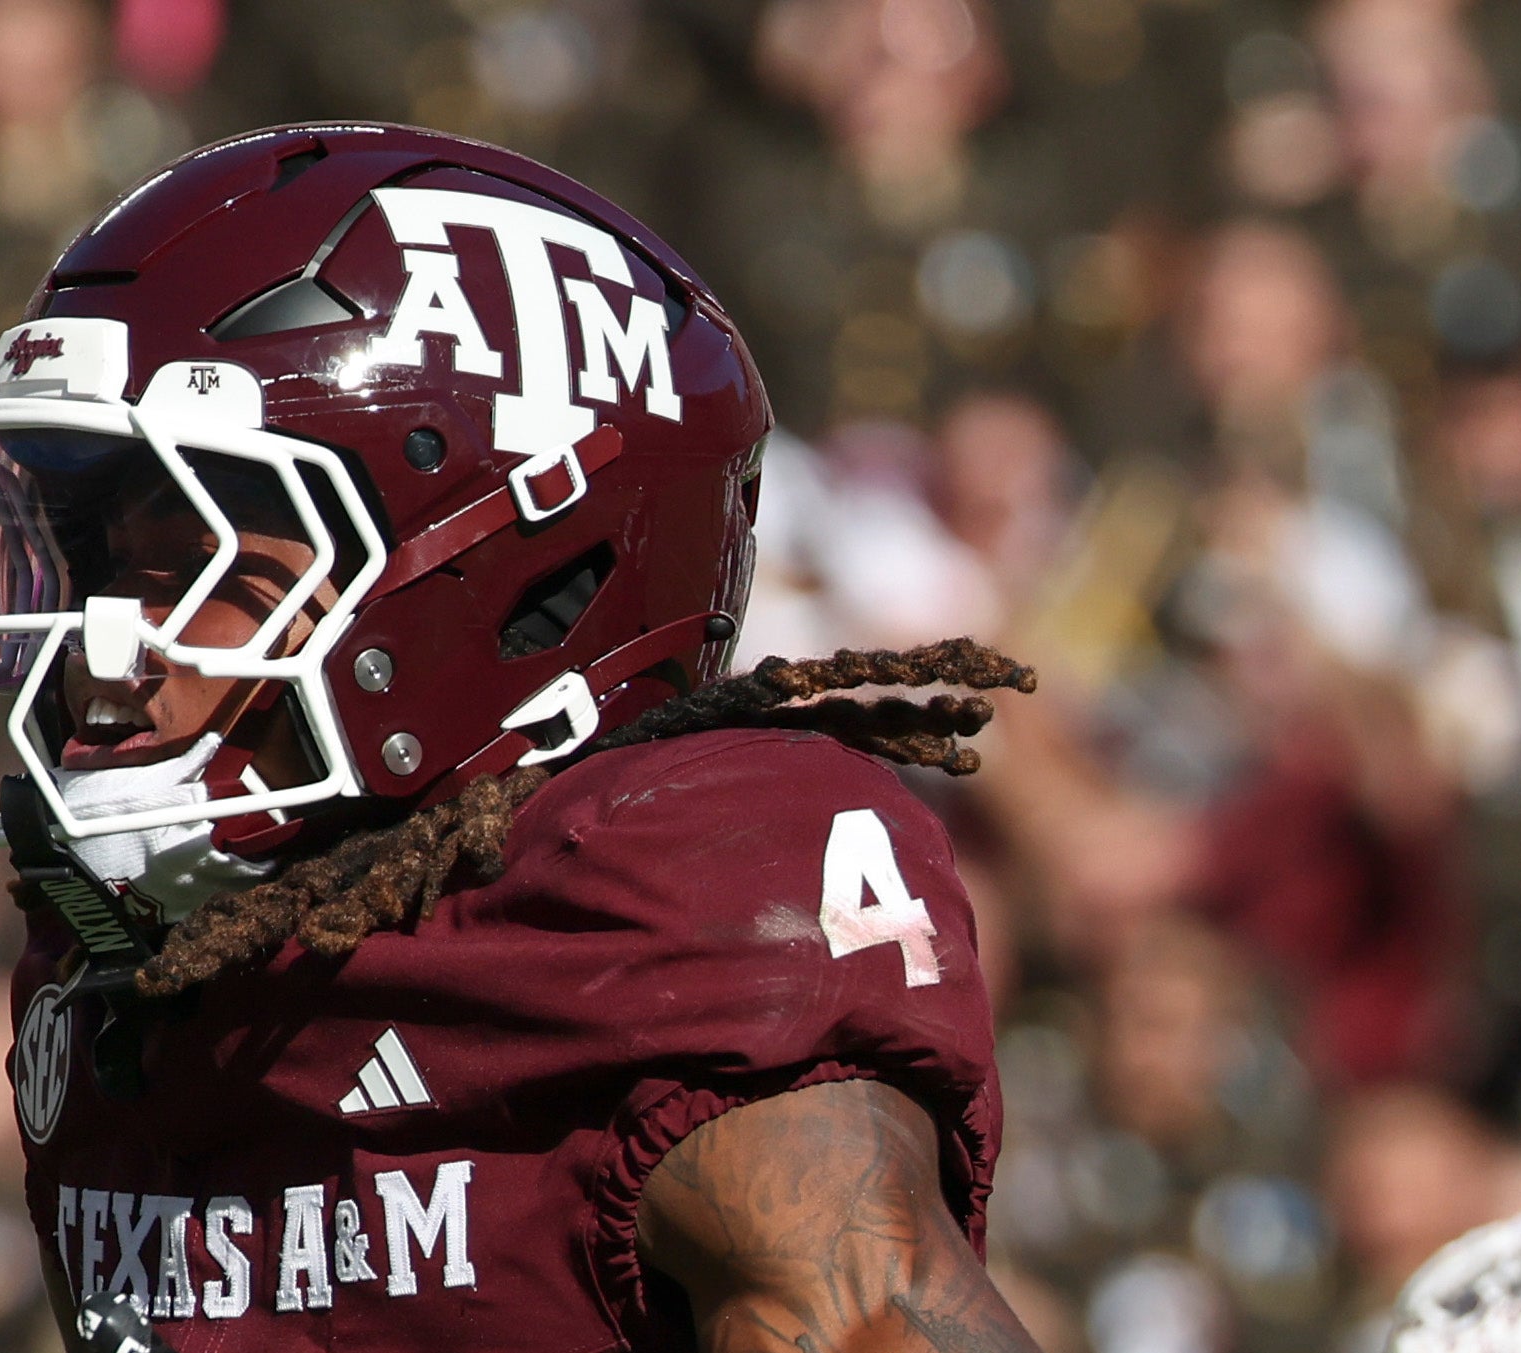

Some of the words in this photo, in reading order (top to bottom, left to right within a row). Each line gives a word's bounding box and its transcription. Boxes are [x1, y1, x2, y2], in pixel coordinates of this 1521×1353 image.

[819, 808, 941, 986] 4
[20, 995, 67, 1133] SEC
[276, 1160, 475, 1310] A&M
